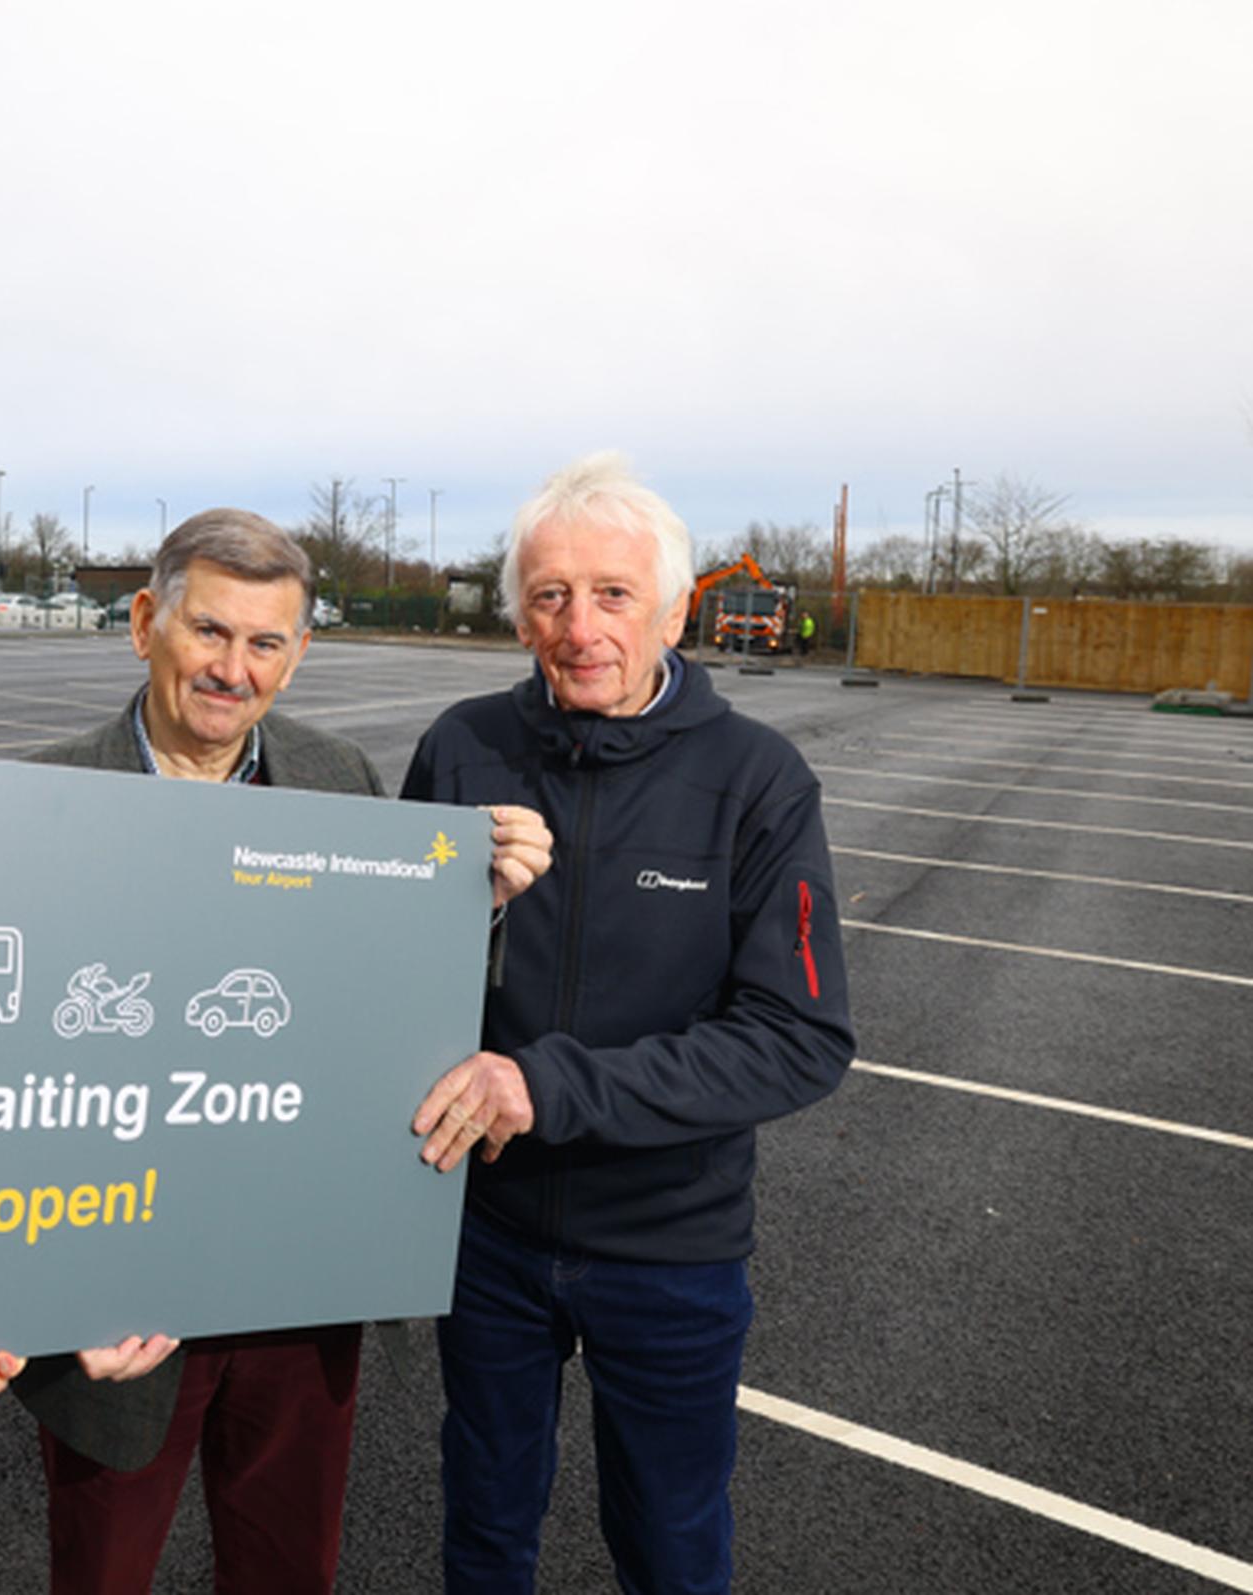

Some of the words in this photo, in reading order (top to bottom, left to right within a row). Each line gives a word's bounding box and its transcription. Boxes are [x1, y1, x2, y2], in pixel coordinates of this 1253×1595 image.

[233, 846, 327, 873] Newcastle
[330, 854, 435, 880] International
[233, 870, 264, 886] Your
[266, 871, 313, 889] Airport
[165, 1071, 303, 1124] Zone
